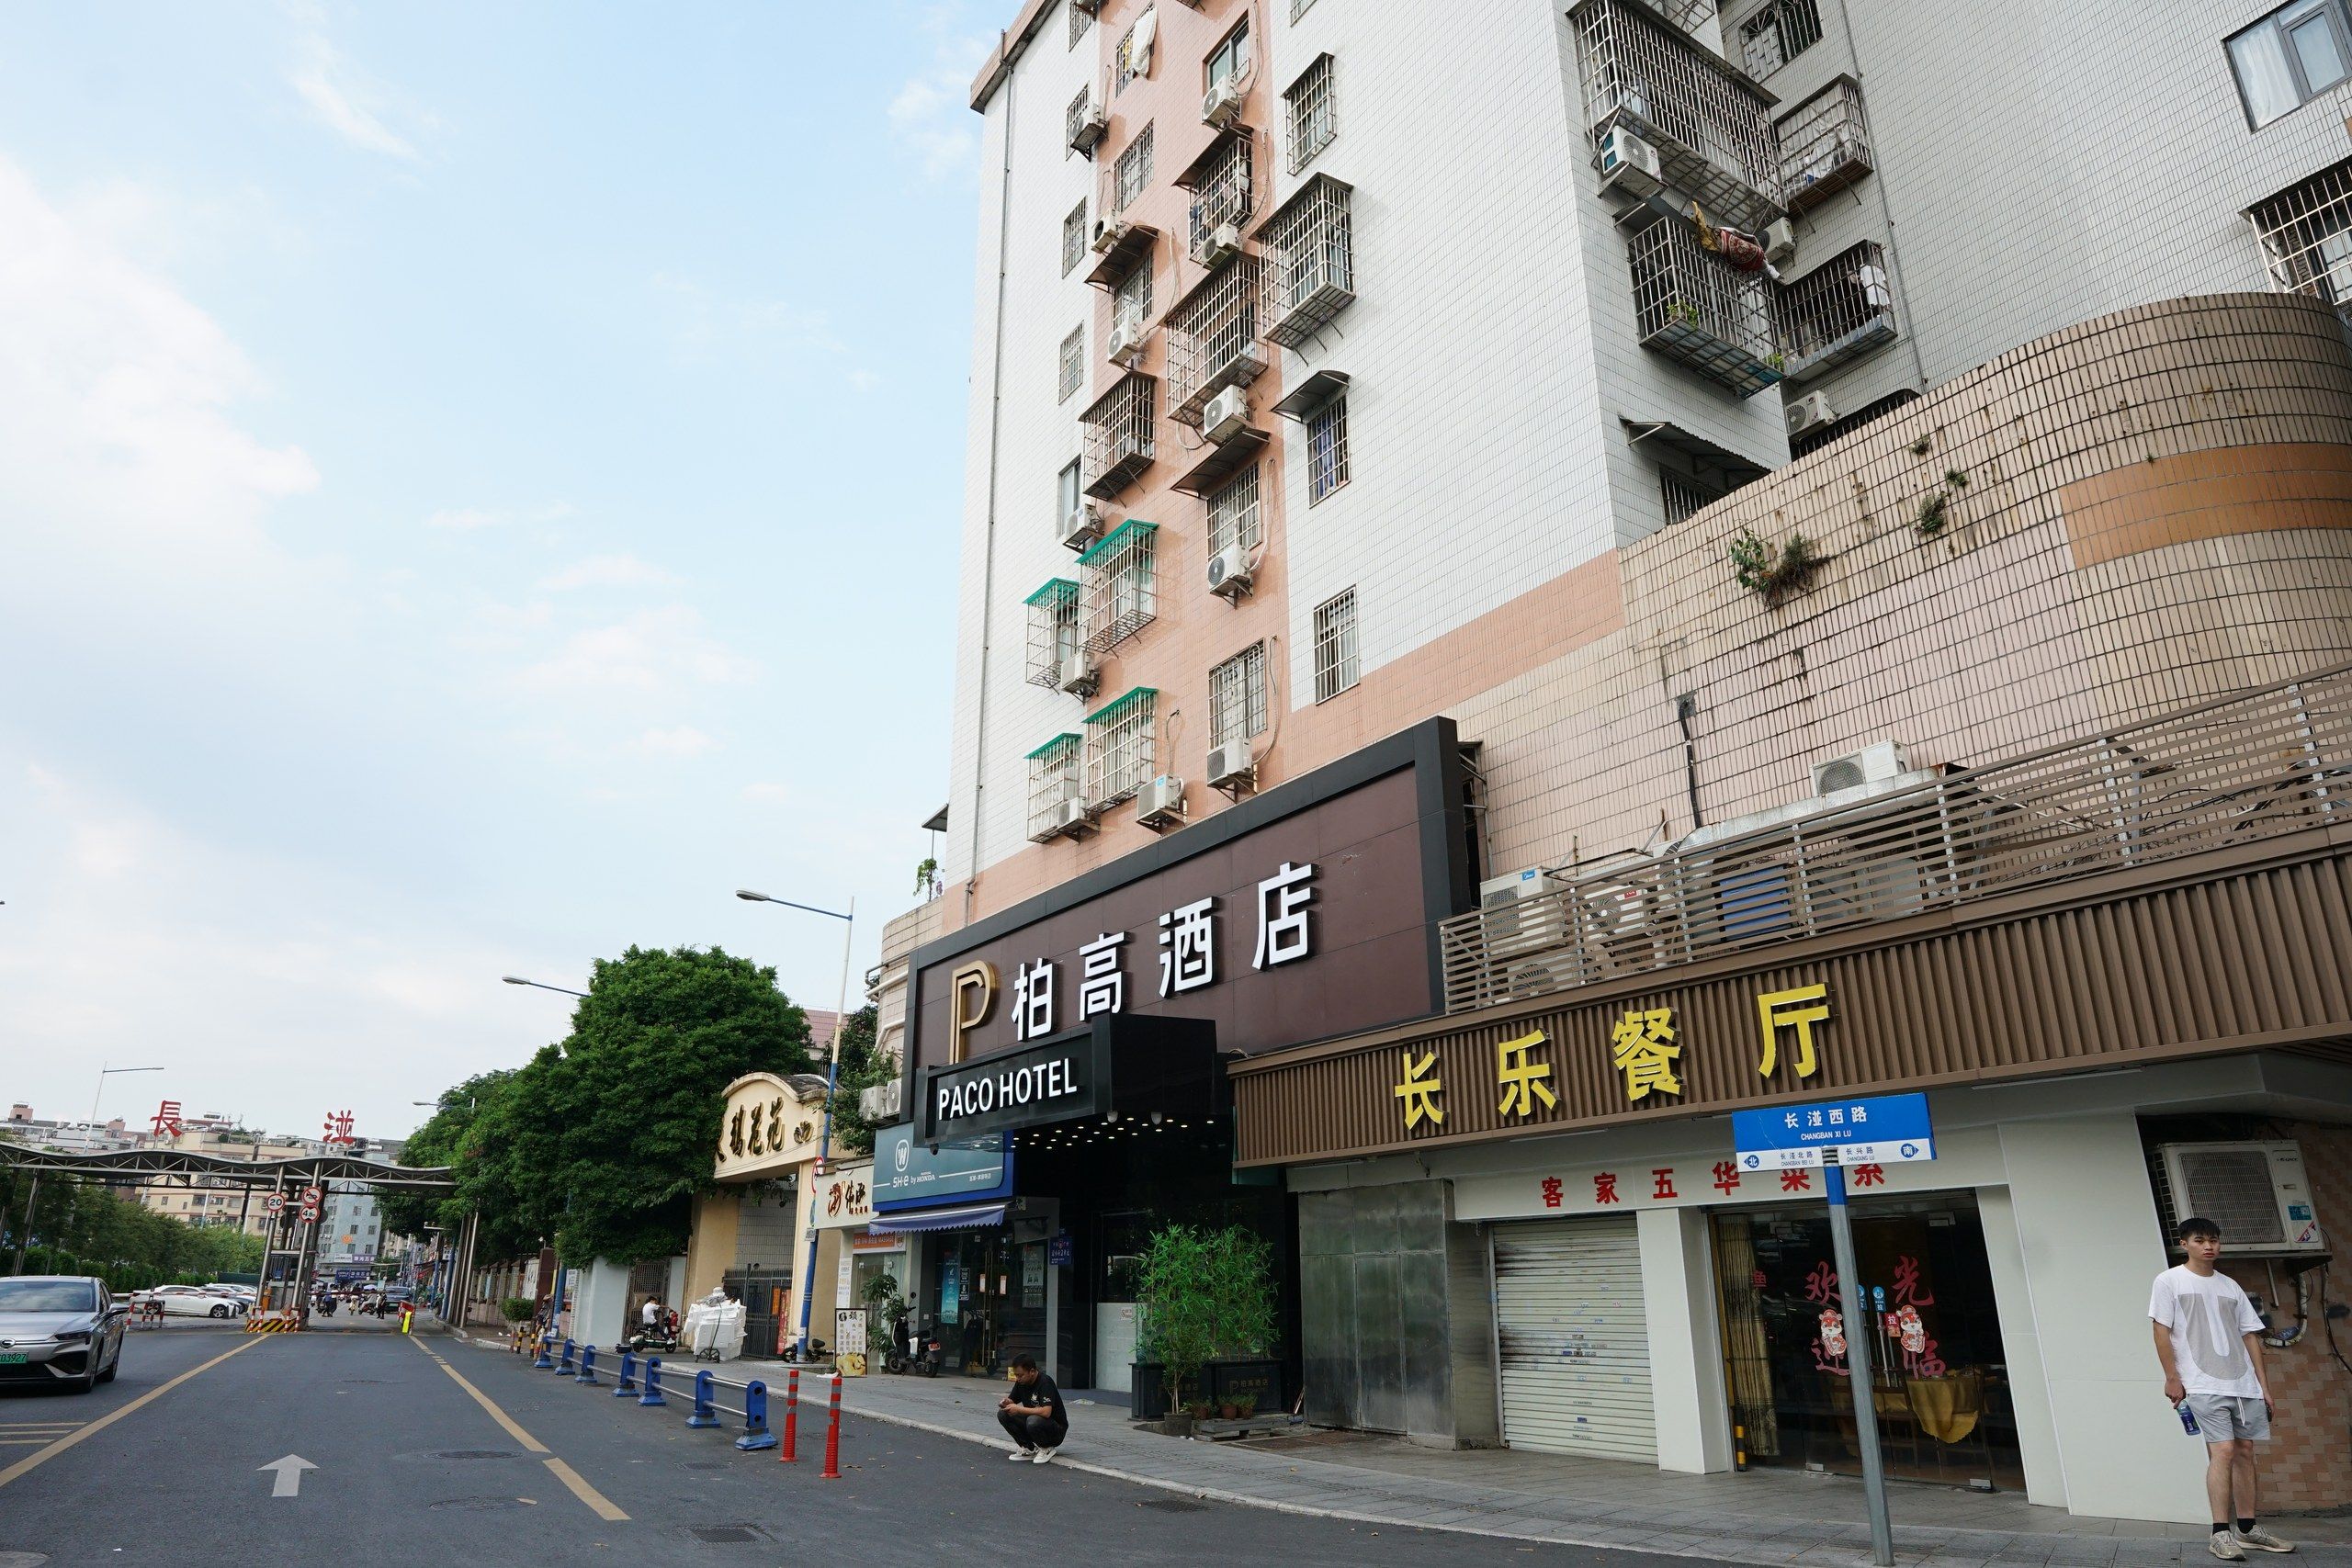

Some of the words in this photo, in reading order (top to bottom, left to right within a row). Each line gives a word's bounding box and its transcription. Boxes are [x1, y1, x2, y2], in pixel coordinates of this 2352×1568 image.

[1012, 862, 1321, 1041] 柏高酒店
[1395, 983, 1832, 1130] 长乐餐厅
[939, 1077, 993, 1121] PACO
[999, 1057, 1078, 1108] HOTEL
[1801, 1131, 1833, 1141] CHANGBAN
[1846, 1146, 1873, 1156] 长兴路
[1903, 1146, 1914, 1156] 南
[1888, 1314, 1897, 1325] 拉
[0, 1353, 27, 1363] 03927
